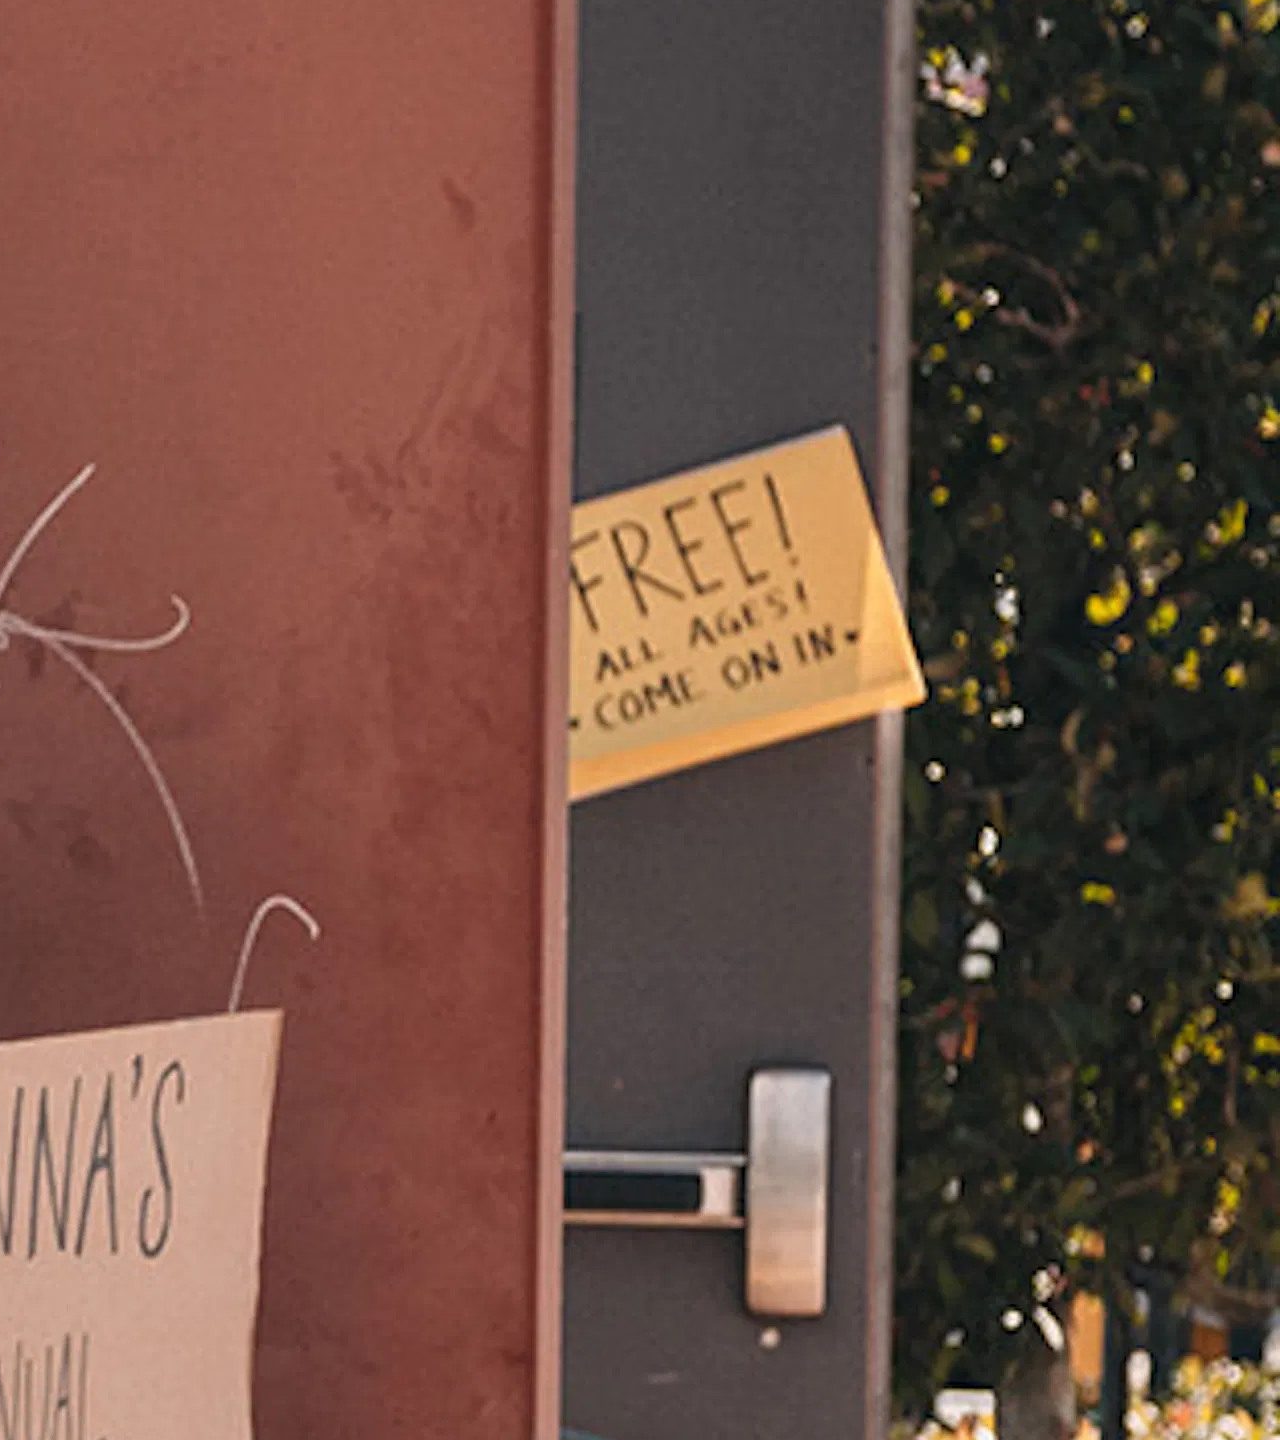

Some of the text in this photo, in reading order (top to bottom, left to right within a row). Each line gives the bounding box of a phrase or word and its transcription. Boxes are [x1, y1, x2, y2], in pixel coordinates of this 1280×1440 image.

[571, 472, 800, 633] FREE!
[594, 636, 662, 684] ALL
[594, 670, 705, 730] COME
[721, 640, 782, 691] ON
